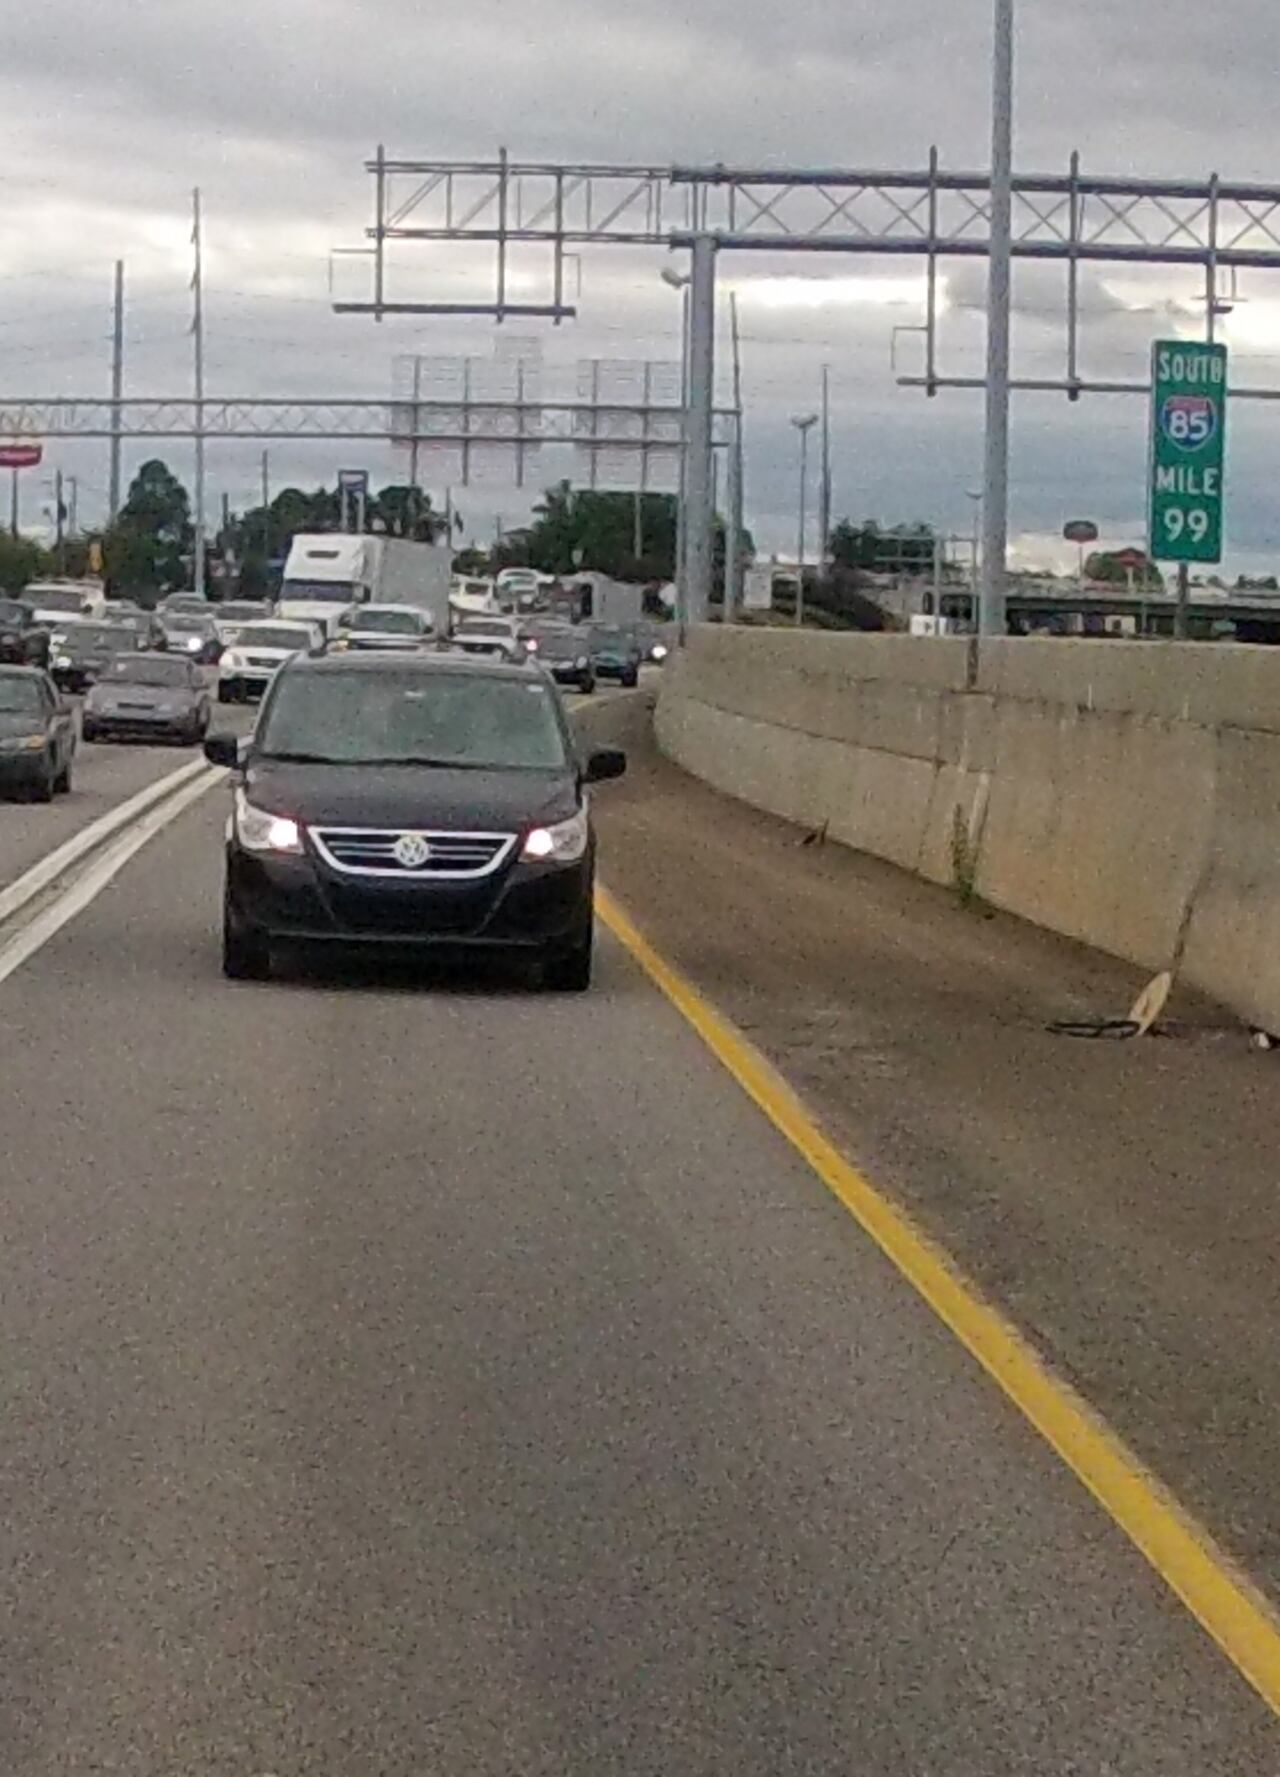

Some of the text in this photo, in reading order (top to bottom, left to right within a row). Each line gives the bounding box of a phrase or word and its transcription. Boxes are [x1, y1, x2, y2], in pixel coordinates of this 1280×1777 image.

[1158, 351, 1222, 384] SOUTH
[1169, 410, 1209, 440] 85
[1155, 465, 1219, 496] MILE
[1164, 508, 1208, 543] 99
